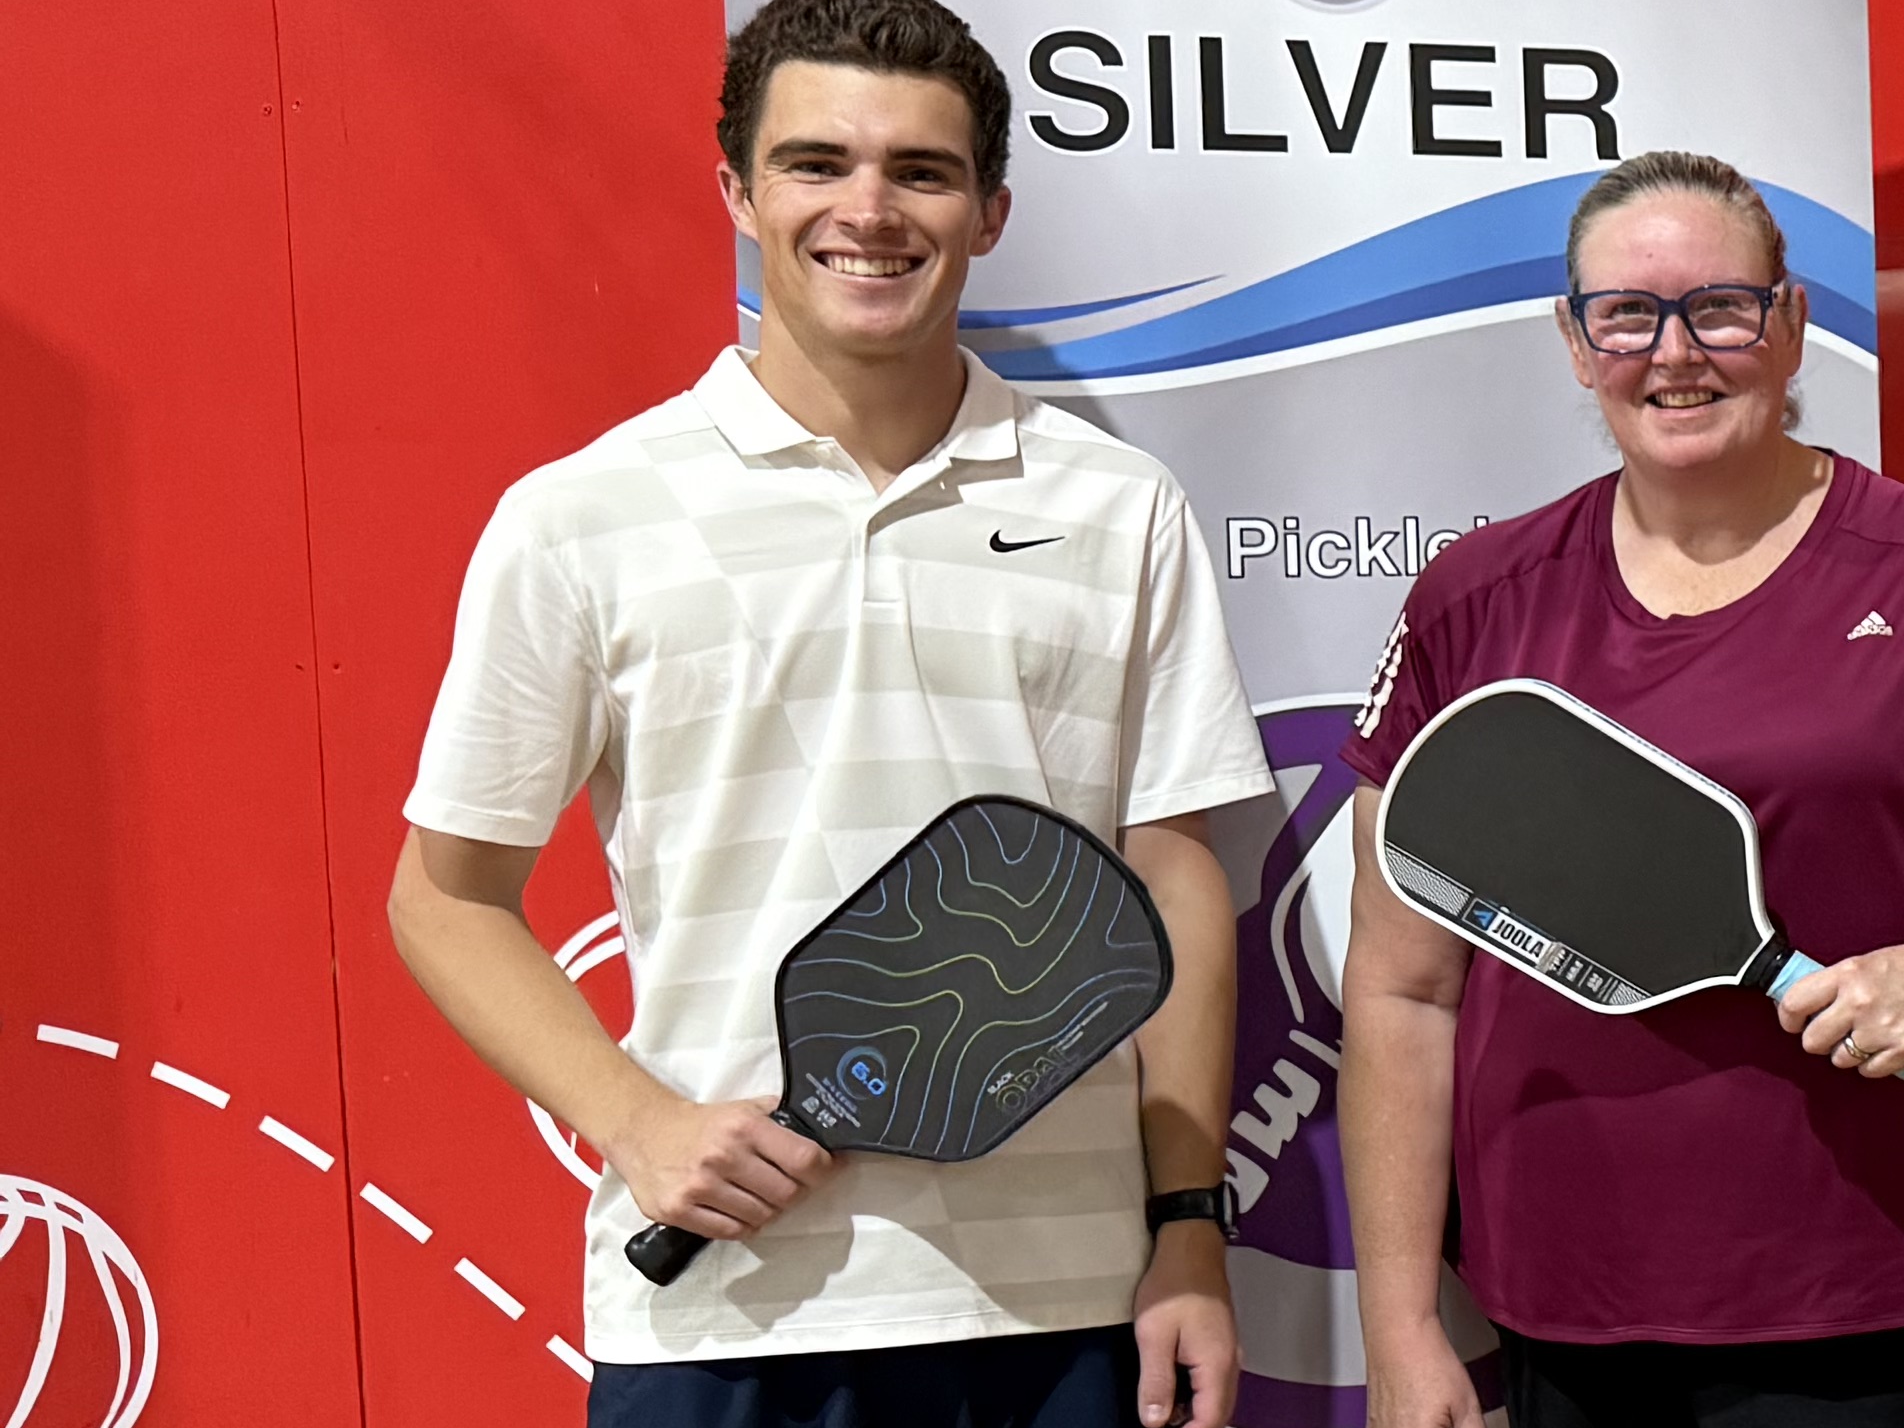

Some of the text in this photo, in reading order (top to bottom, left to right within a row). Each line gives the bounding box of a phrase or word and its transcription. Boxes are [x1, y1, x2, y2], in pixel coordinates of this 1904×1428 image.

[1028, 29, 1622, 161] SILVER
[1226, 516, 1490, 579] Pickl
[1491, 918, 1545, 959] JOOLA
